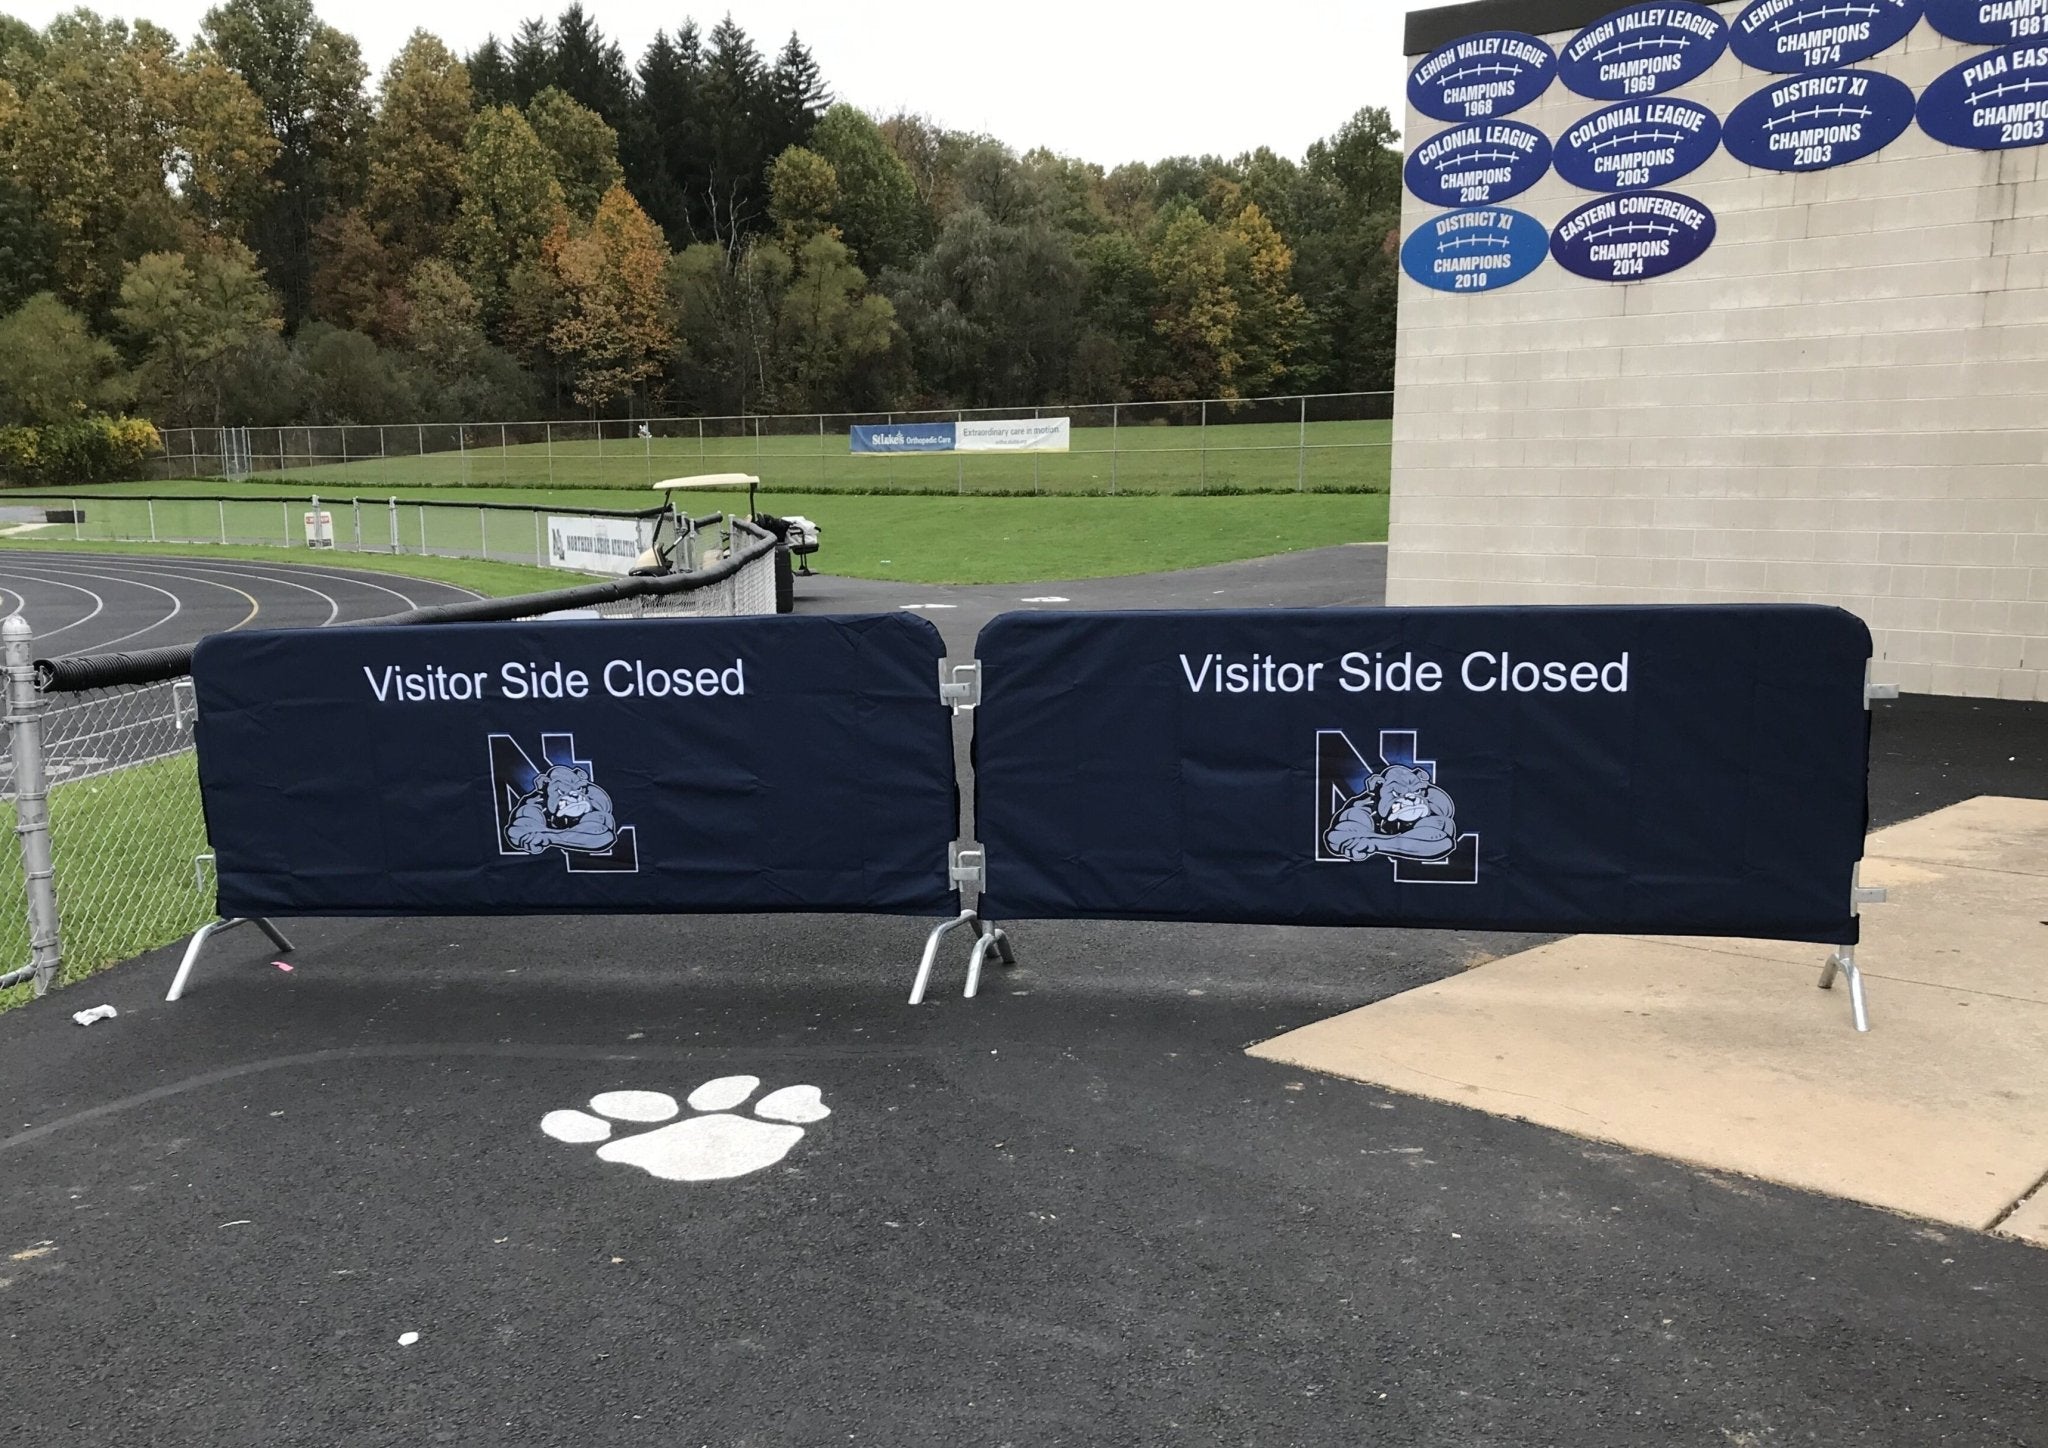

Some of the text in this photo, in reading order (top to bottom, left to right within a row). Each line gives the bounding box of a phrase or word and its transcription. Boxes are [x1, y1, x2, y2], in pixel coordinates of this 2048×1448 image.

[1568, 8, 1719, 62] LEHIGH VALLEY LEAGUE
[1777, 22, 1870, 54] CHAMPIONS
[2010, 14, 2048, 38] 1981
[1414, 38, 1548, 86] LEHIGH VALLEY LEAGUE
[1599, 53, 1682, 82] CHAMPIONS
[1803, 45, 1841, 67] 1974
[1962, 47, 2048, 88] PIAA EAS
[1443, 79, 1516, 104] CHAMPIONS
[1623, 74, 1656, 95] 1969
[1771, 76, 1869, 108] DISTRICT XI
[1464, 99, 1493, 117] 1968
[1569, 104, 1706, 149] COLONIAL LEAGUE
[1769, 123, 1862, 151] CHAMPIONS
[2000, 119, 2045, 143] 2003
[1418, 126, 1539, 166] COLONIAL LEAGUE
[1793, 145, 1832, 166] 2003
[1594, 147, 1676, 173] CHAMPIONS
[1440, 167, 1512, 190] CHAMPIONS
[1616, 167, 1650, 187] 2003
[1460, 184, 1490, 203] 2002
[1436, 211, 1514, 237] DISTRICT XI
[1559, 197, 1706, 242] EASTERN CONFERENCE
[1589, 239, 1670, 262] CHAMPIONS
[1433, 253, 1512, 274] CHAMPIONS
[1612, 257, 1644, 276] 2014
[1454, 272, 1487, 289] 2010
[963, 427, 1008, 437] Extraordinary
[1010, 428, 1025, 436] care
[1034, 425, 1060, 435] motion
[363, 657, 746, 702] Visitor Side Closed
[1178, 650, 1630, 693] Visitor Side Closed
